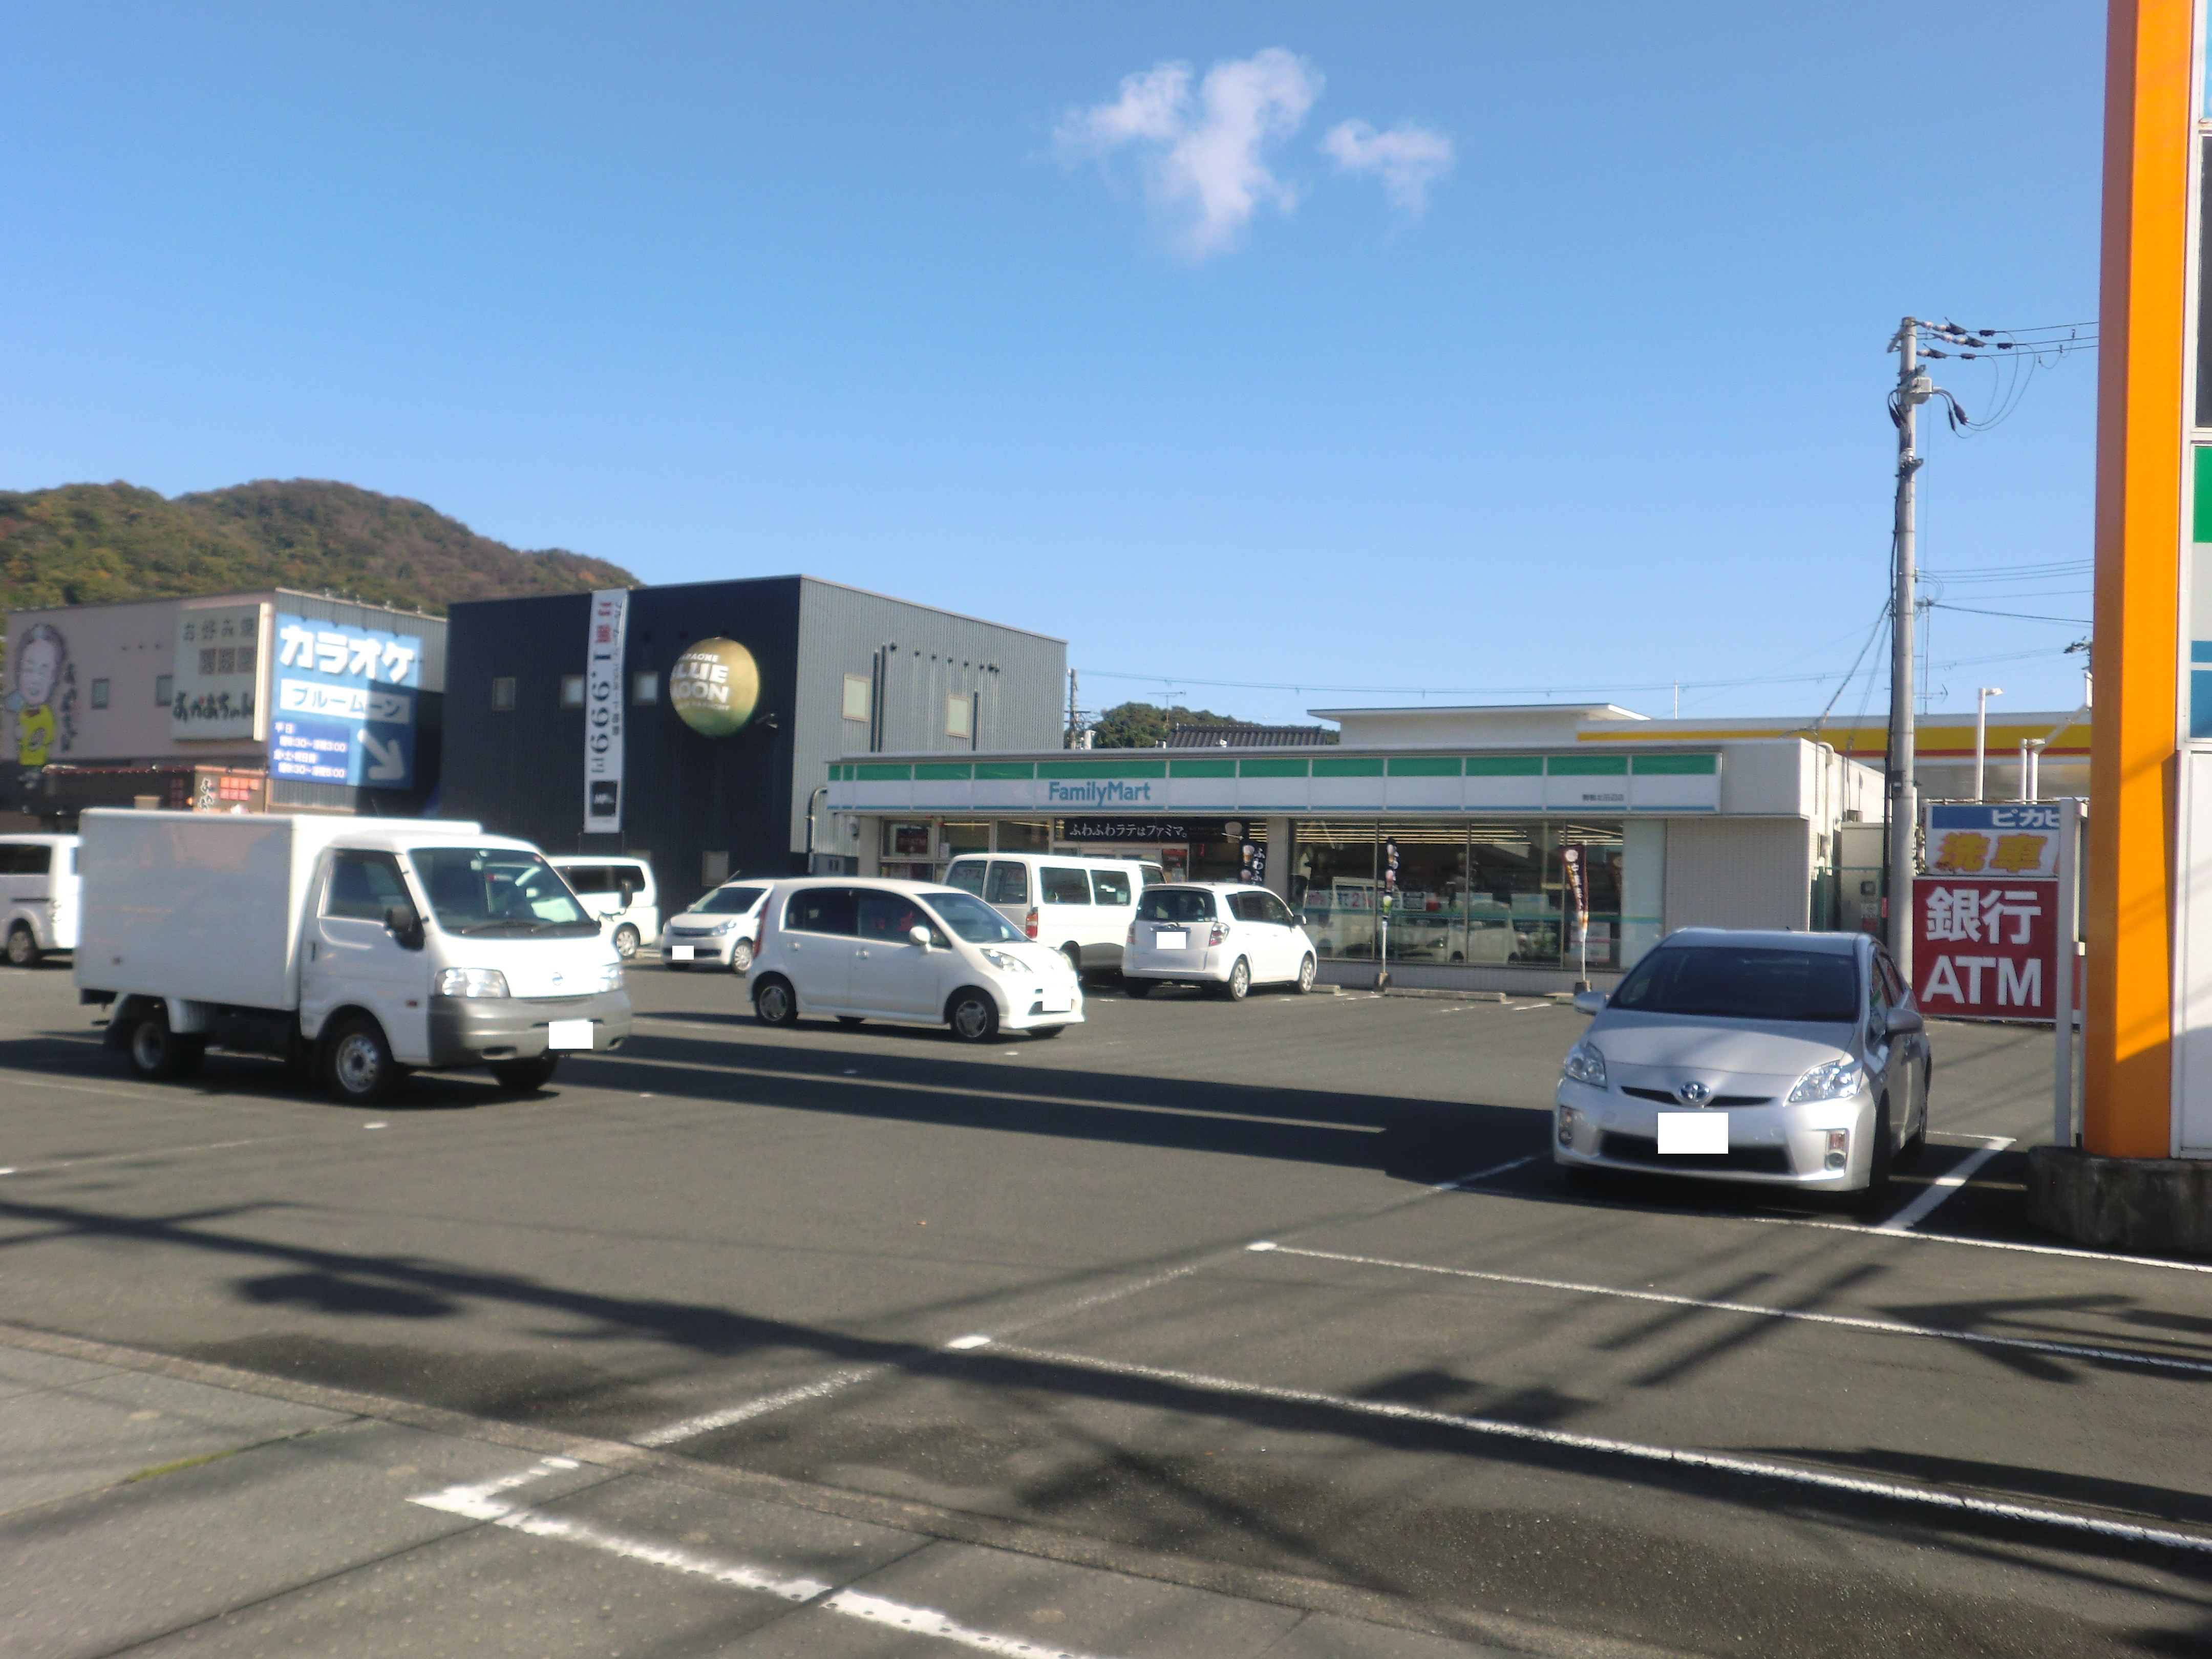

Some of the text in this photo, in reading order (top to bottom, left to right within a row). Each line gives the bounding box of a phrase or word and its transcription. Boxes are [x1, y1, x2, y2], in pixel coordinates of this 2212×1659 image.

[280, 625, 414, 683] カラオケ
[292, 688, 400, 717] ブルームーン
[1049, 781, 1151, 807] FamilyMart
[1070, 822, 1187, 838] ふわふわラテはファミマ。
[1933, 832, 2059, 874] 洗車
[1926, 886, 2041, 945] 銀行
[1921, 955, 2041, 1007] ATM
